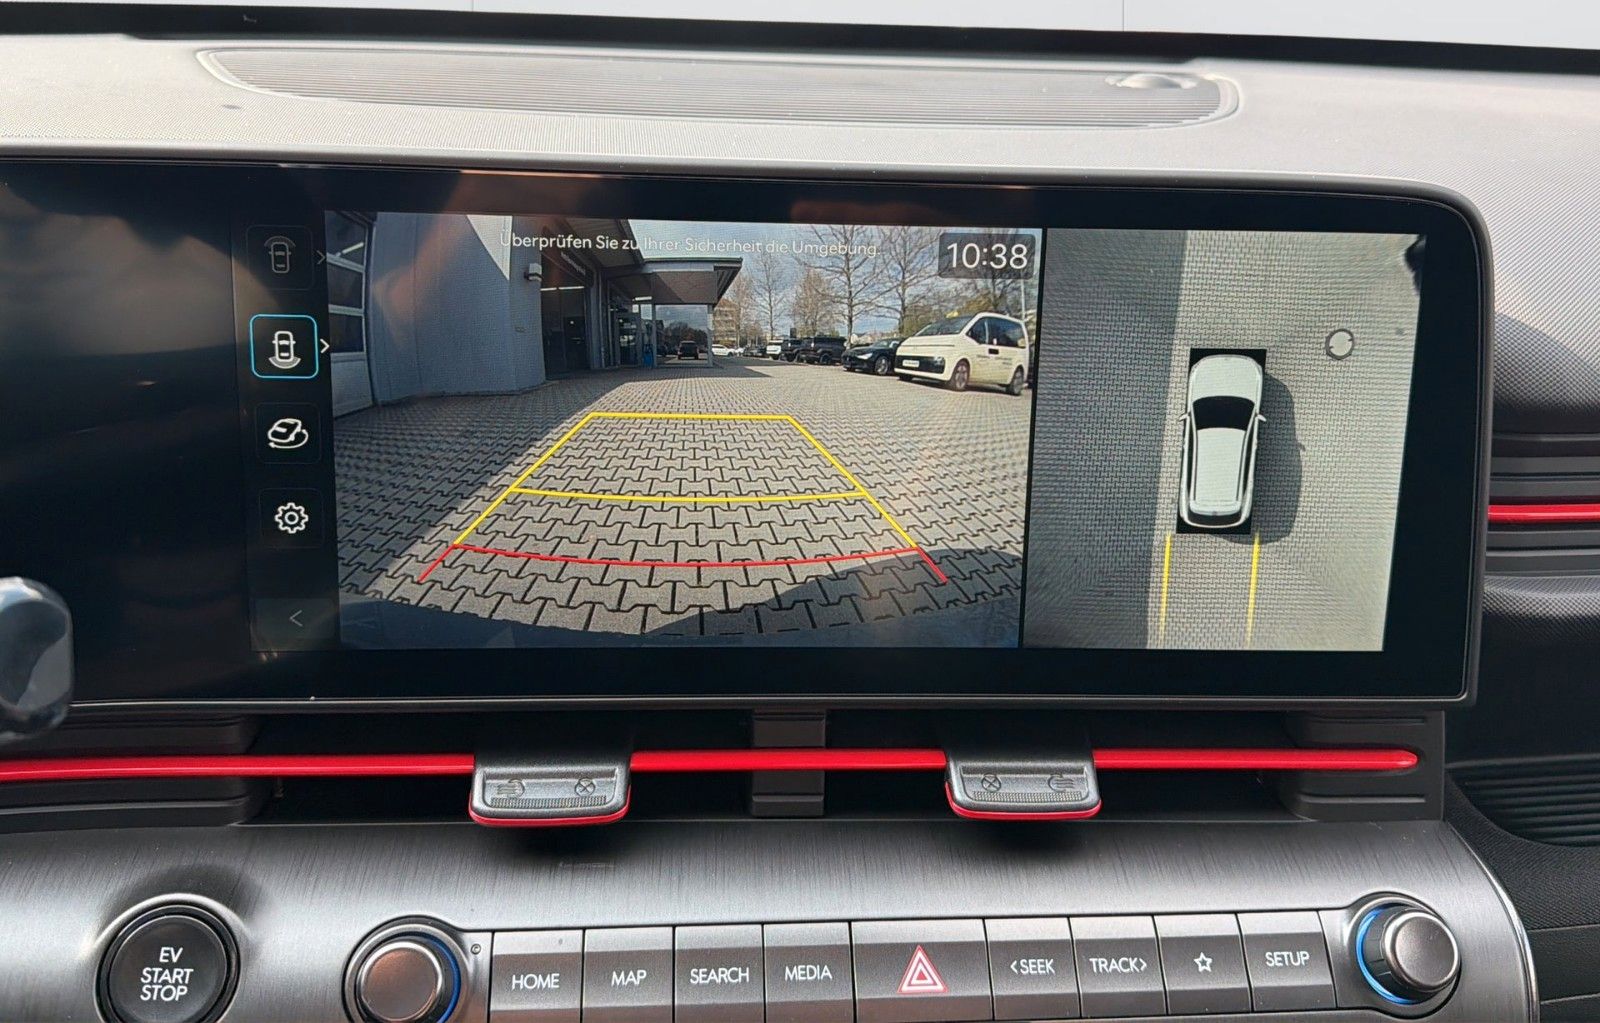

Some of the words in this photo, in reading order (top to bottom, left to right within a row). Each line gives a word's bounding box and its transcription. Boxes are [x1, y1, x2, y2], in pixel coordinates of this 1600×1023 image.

[499, 229, 592, 250] Überprüfen
[596, 235, 619, 249] Sie
[622, 239, 640, 250] zu
[644, 237, 681, 251] Ihrer
[685, 237, 763, 253] Sicherheit
[766, 240, 789, 254] die
[947, 242, 1028, 269] 10:38
[159, 946, 184, 963] EV
[1265, 951, 1311, 967] SETUP
[140, 967, 194, 984] START
[511, 973, 560, 990] HOME
[611, 969, 647, 987] MAP
[690, 966, 750, 984] SEARCH
[785, 965, 833, 982] MEDIA
[140, 984, 188, 1001] STOP
